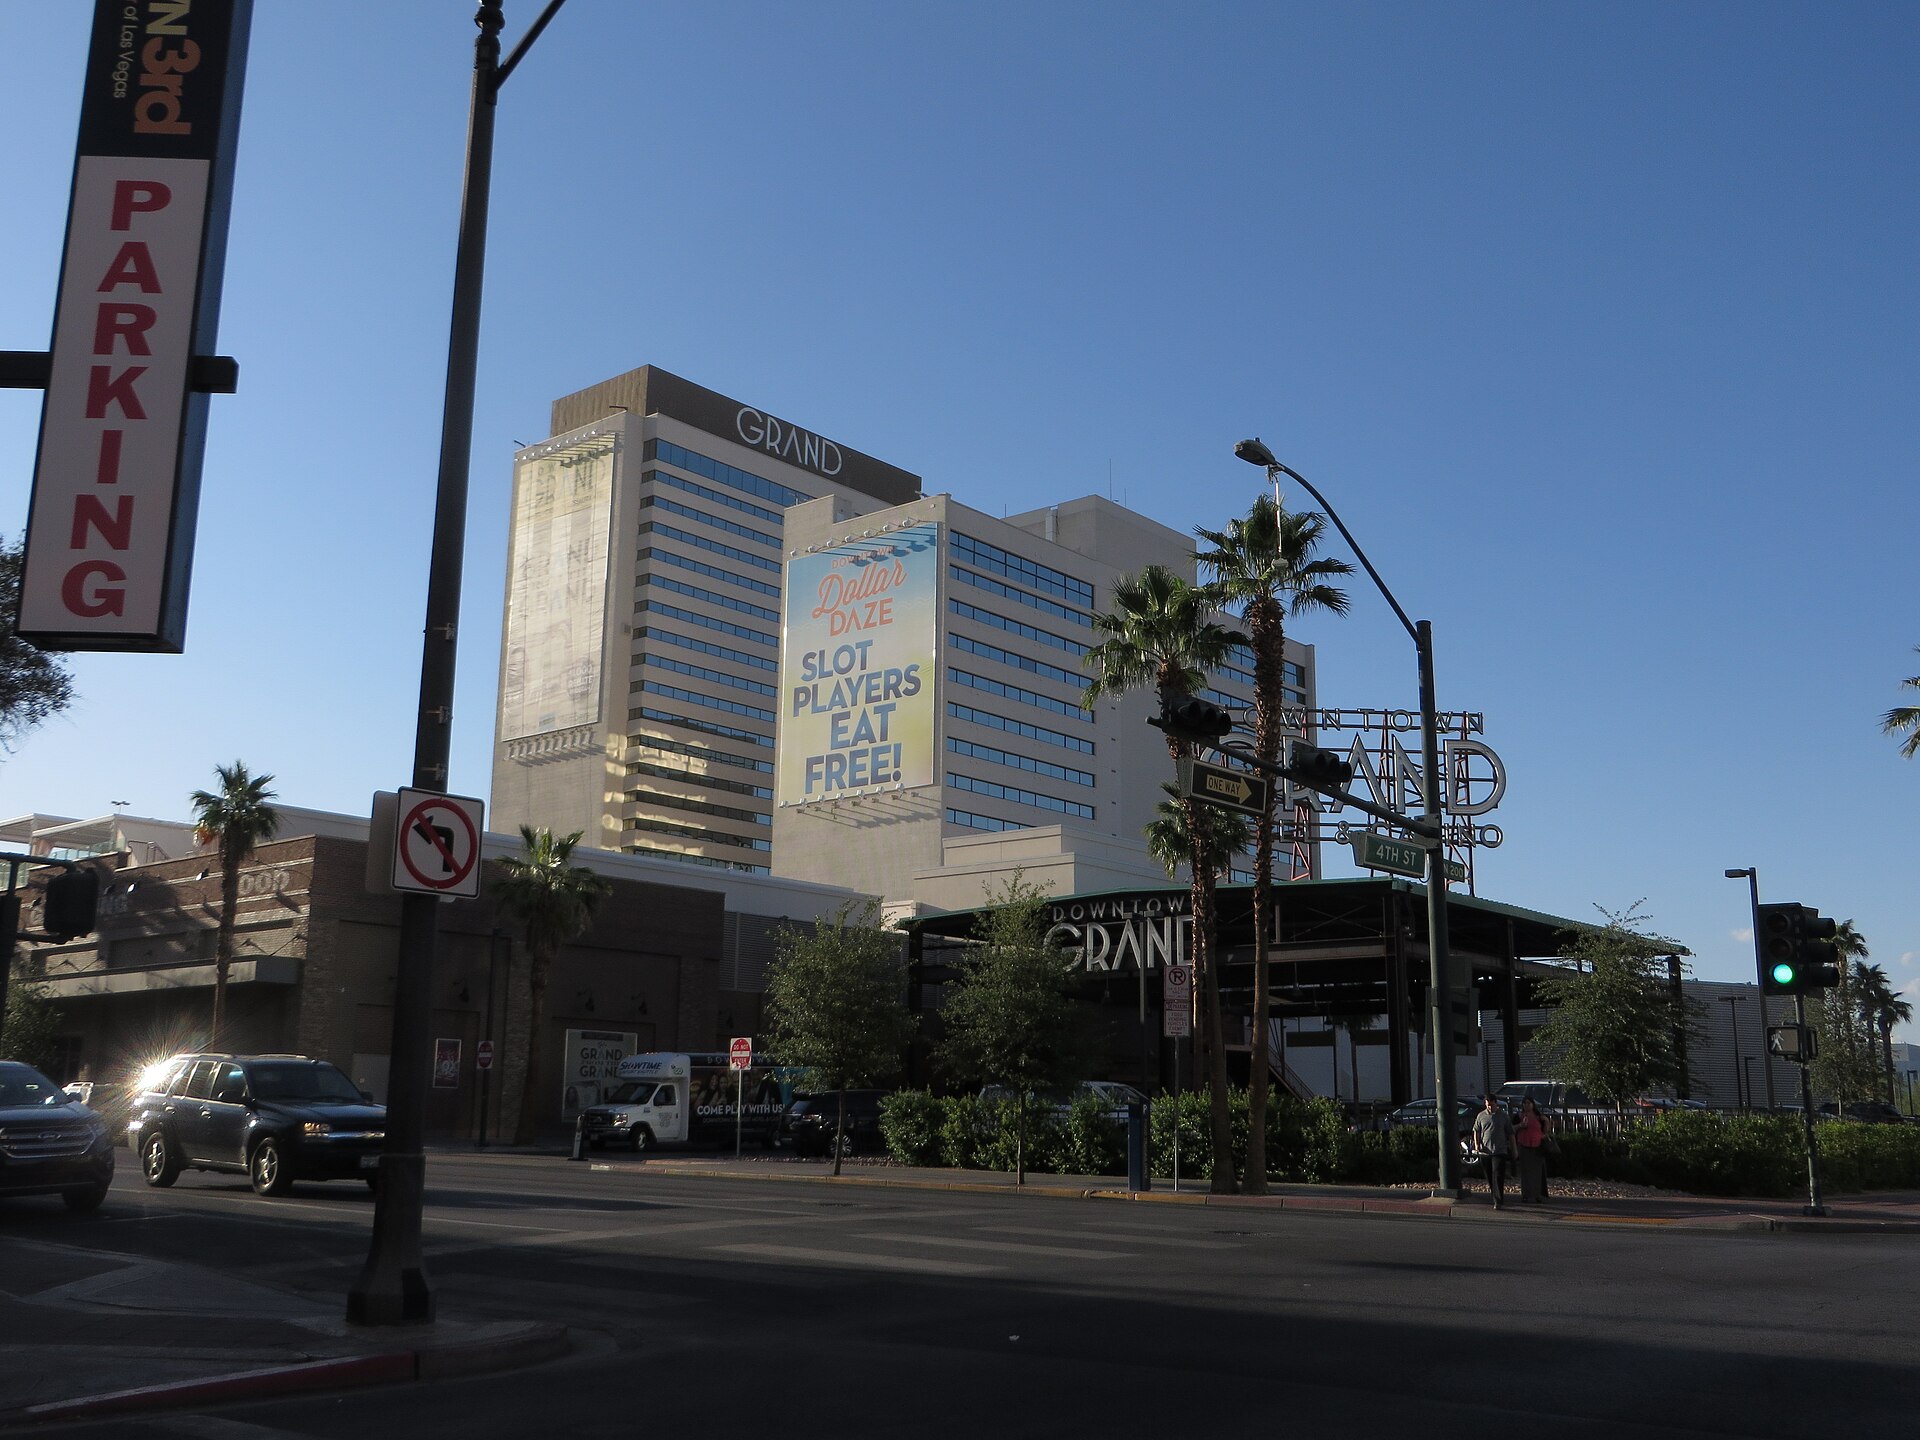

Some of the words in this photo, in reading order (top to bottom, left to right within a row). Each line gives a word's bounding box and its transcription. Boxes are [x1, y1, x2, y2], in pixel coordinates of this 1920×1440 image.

[123, 6, 139, 21] of
[119, 25, 138, 48] Las
[112, 51, 135, 98] Vegas
[134, 0, 201, 134] N3rd
[61, 180, 172, 618] PARKING
[736, 407, 842, 475] GRAND
[812, 559, 907, 619] Dollar
[830, 597, 894, 637] DAZE
[801, 640, 873, 682] SLOT
[793, 664, 921, 717] PLAYERS
[831, 703, 896, 750] EAT
[1242, 706, 1484, 735] OWNTOWN
[805, 743, 902, 794] FREE!
[1208, 777, 1223, 791] ONE
[1225, 782, 1240, 796] WAY
[1335, 820, 1353, 845] &
[1371, 821, 1504, 849] CINO
[1376, 844, 1399, 863] 4TH
[1403, 850, 1416, 866] ST
[1450, 864, 1463, 878] 200
[1053, 895, 1185, 922] DOWNTOW
[580, 1047, 623, 1060] GRAND
[619, 1062, 663, 1071] SHOWTIME
[697, 1105, 724, 1115] COME
[749, 1103, 771, 1114] WITH
